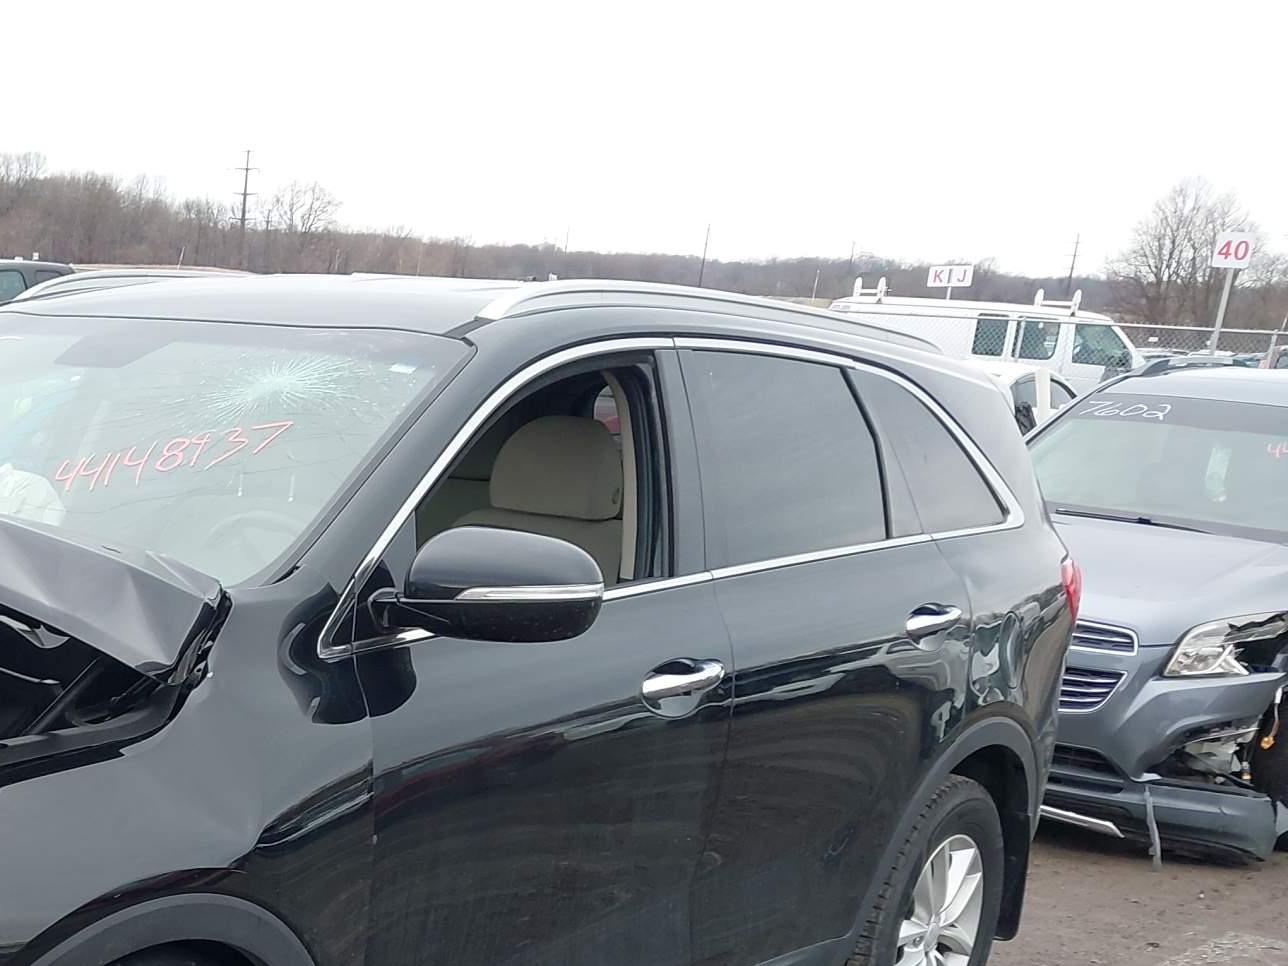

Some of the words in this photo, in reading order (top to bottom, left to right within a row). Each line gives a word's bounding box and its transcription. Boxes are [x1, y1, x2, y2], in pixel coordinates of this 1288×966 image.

[1217, 240, 1250, 260] 40
[1079, 400, 1172, 421] 7602
[55, 420, 295, 492] 44148937
